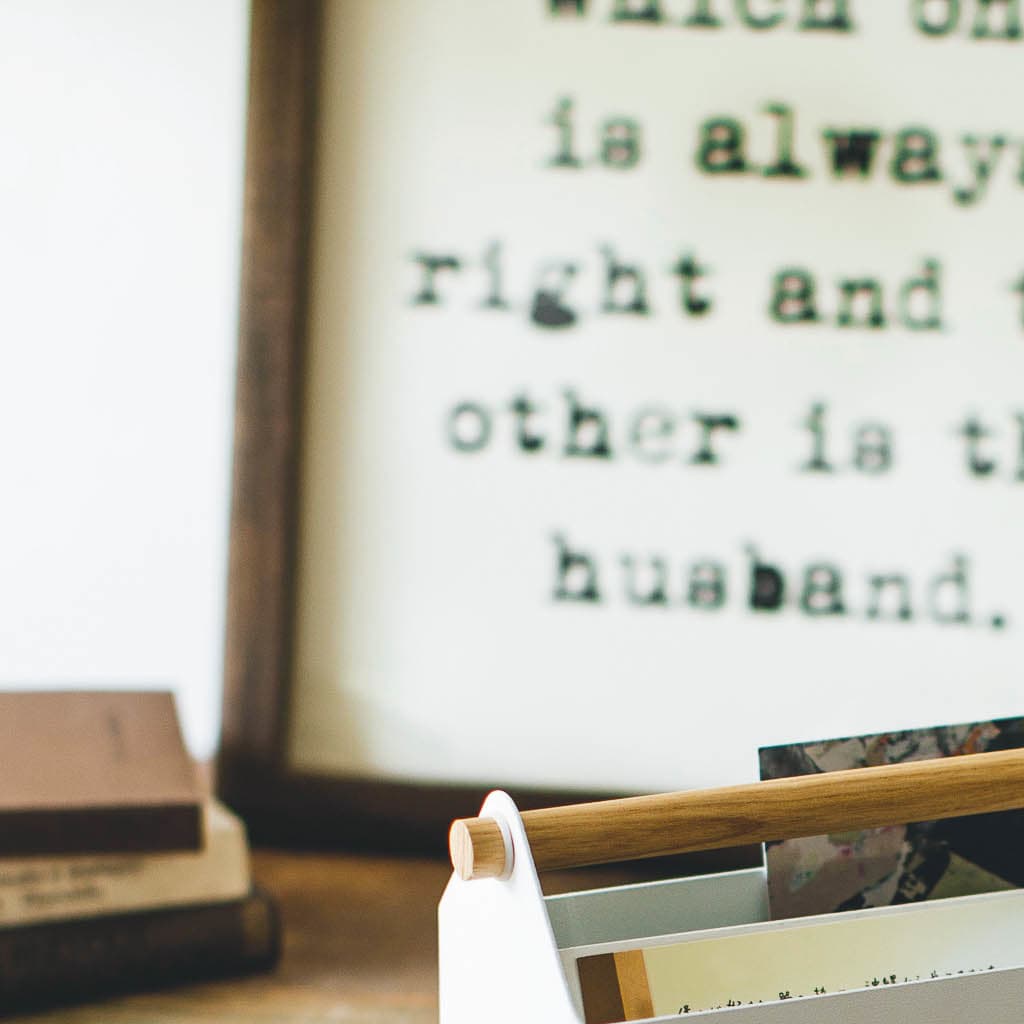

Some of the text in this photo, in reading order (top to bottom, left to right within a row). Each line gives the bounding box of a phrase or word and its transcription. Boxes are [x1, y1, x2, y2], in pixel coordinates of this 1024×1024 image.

[546, 96, 643, 172] is
[410, 242, 715, 332] right
[766, 257, 947, 333] and
[446, 388, 742, 466] other
[800, 402, 896, 475] is
[549, 533, 1008, 631] husband.
